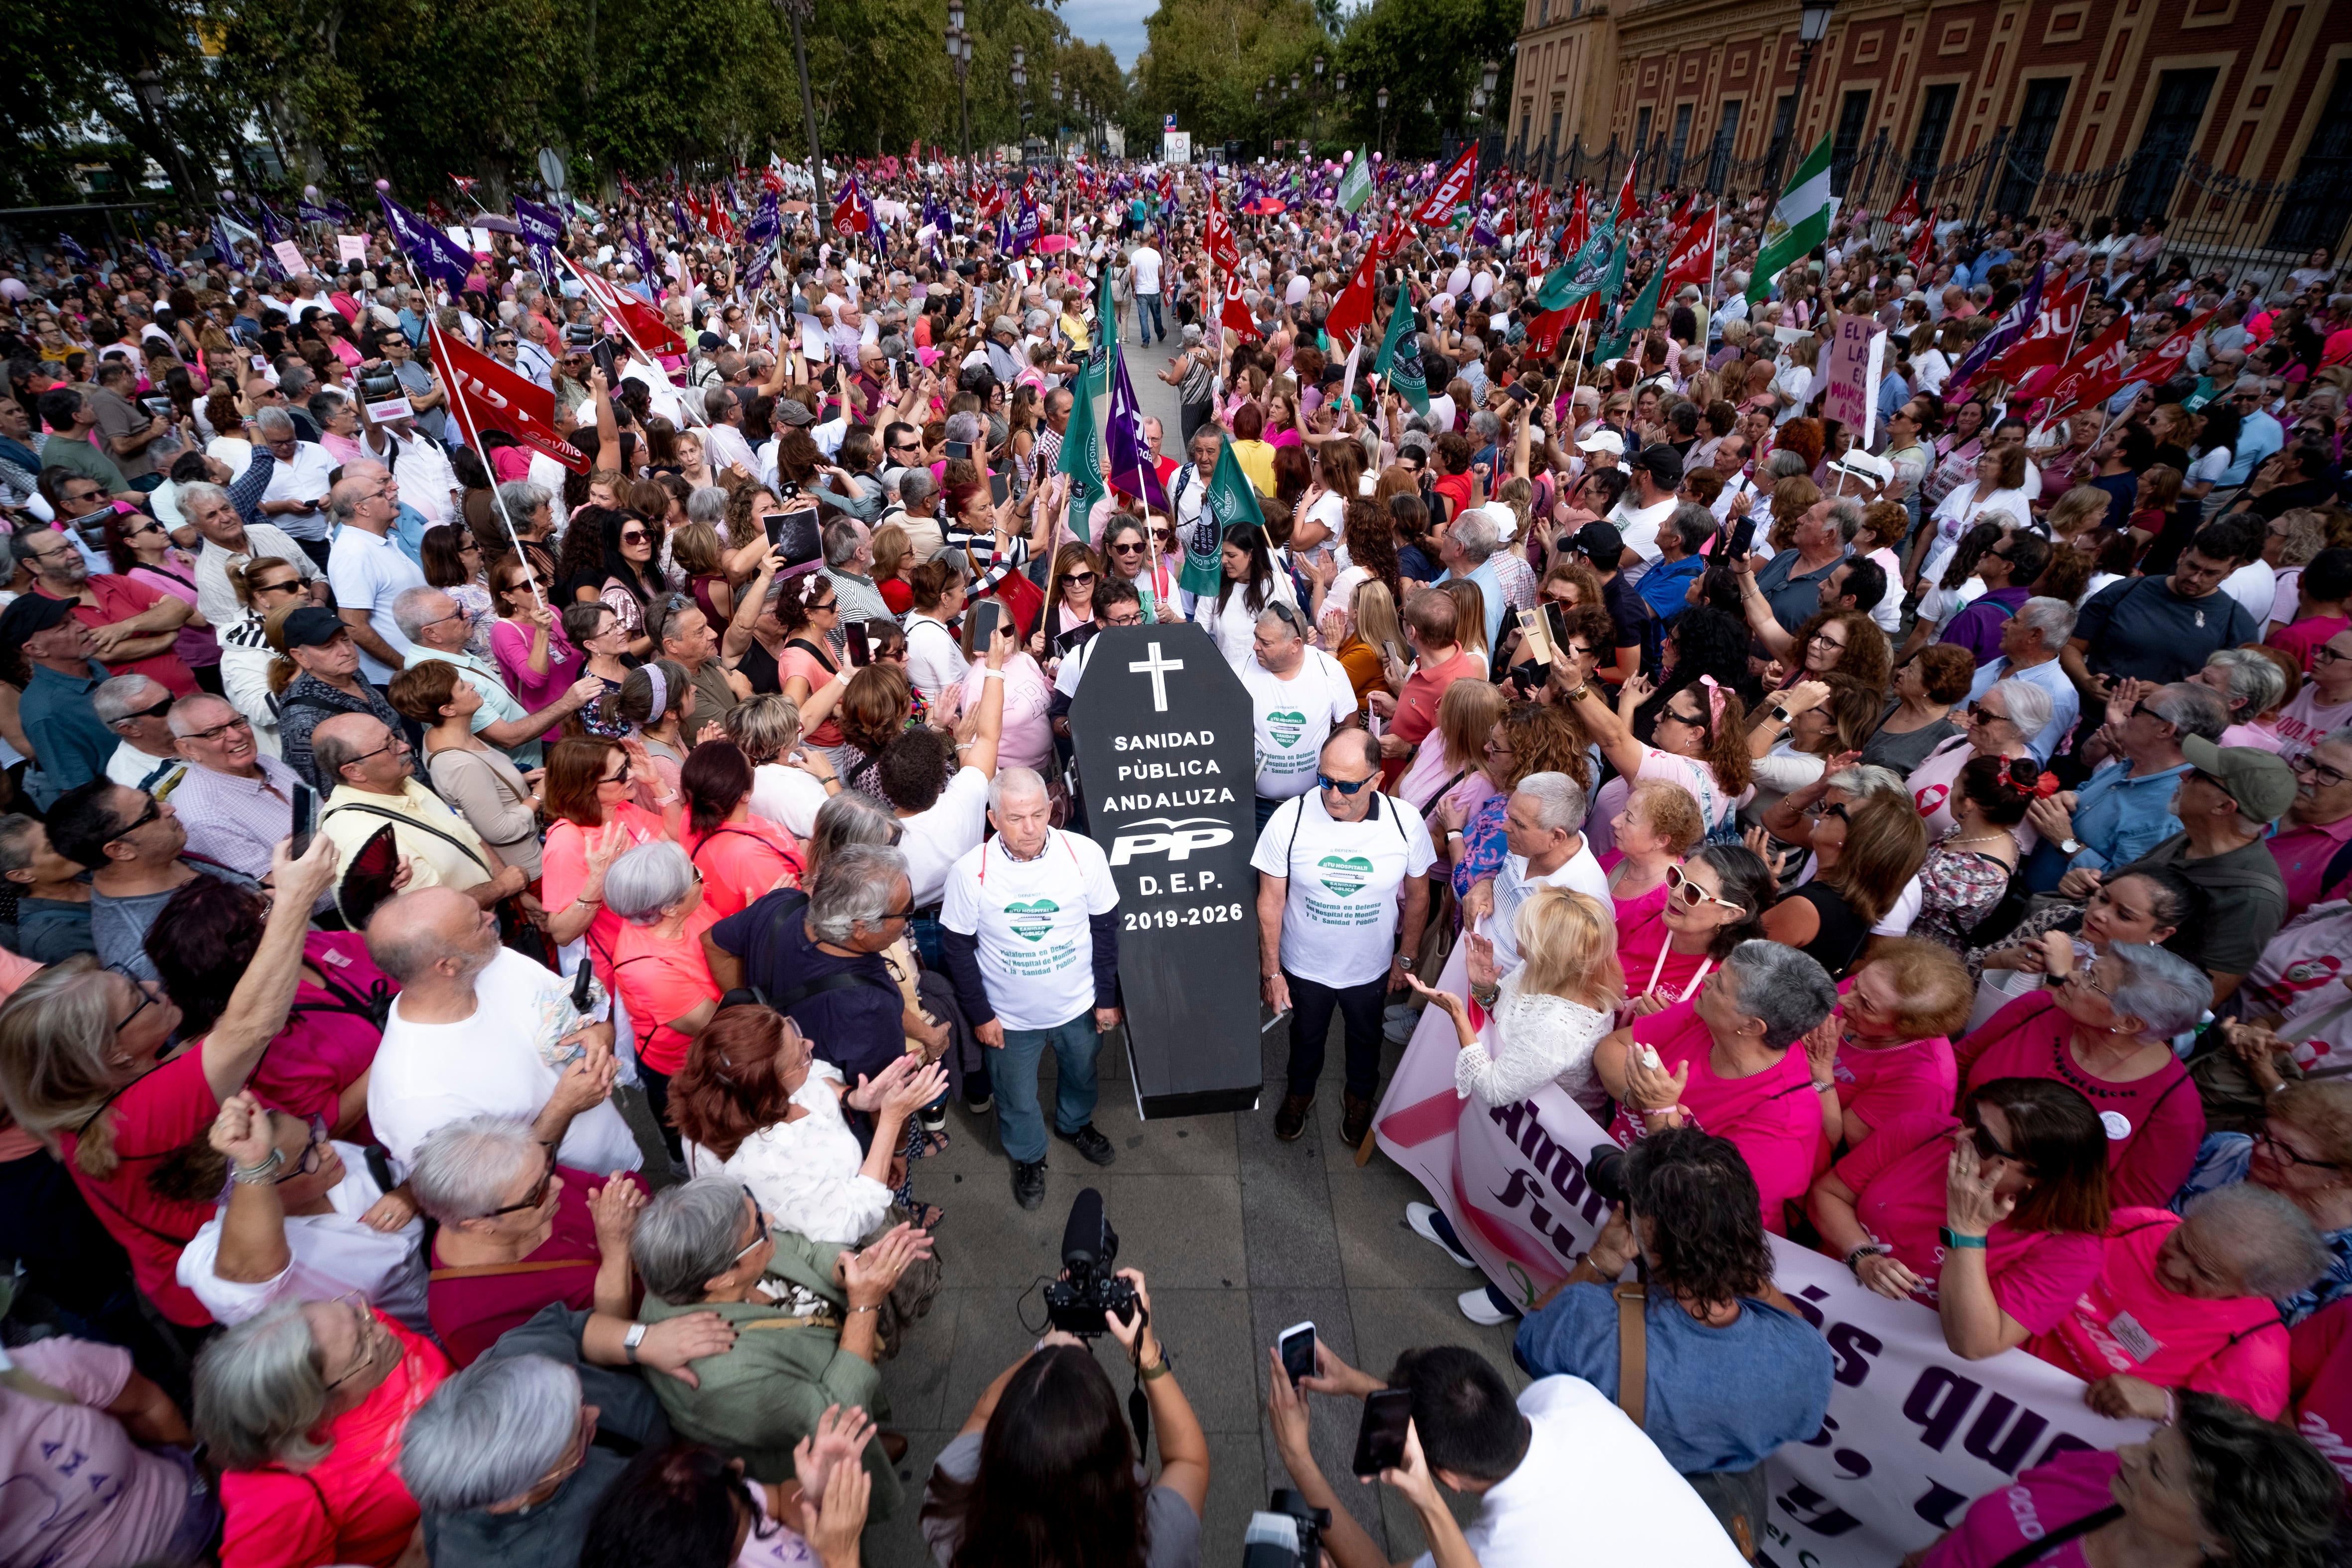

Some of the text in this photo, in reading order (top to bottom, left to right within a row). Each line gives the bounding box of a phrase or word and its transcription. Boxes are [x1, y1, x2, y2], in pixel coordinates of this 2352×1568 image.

[1167, 115, 1173, 125] P
[1219, 244, 1238, 262] Sevilla
[1844, 322, 1861, 340] EL
[527, 431, 582, 458] Sevilla
[1115, 730, 1215, 751] SANIDAD
[1296, 749, 1315, 759] Defensa
[1296, 756, 1316, 767] Montilla
[1298, 763, 1316, 773] Pública
[1103, 787, 1236, 813] ANDALUZA
[1109, 828, 1234, 866] PP
[1336, 862, 1368, 871] HOSPITAL!!
[1305, 896, 1340, 910] Plataforma
[1355, 902, 1382, 911] Defensa
[1124, 903, 1243, 931] 2019-2026
[1306, 904, 1315, 912] del
[1315, 908, 1343, 918] Hospital
[1355, 909, 1380, 919] Montilla
[1322, 918, 1350, 926] Sanidad
[1356, 917, 1379, 926] Pública
[1013, 959, 1042, 967] Hospital
[1022, 967, 1051, 976] Sanidad
[1057, 955, 1076, 970] Pública
